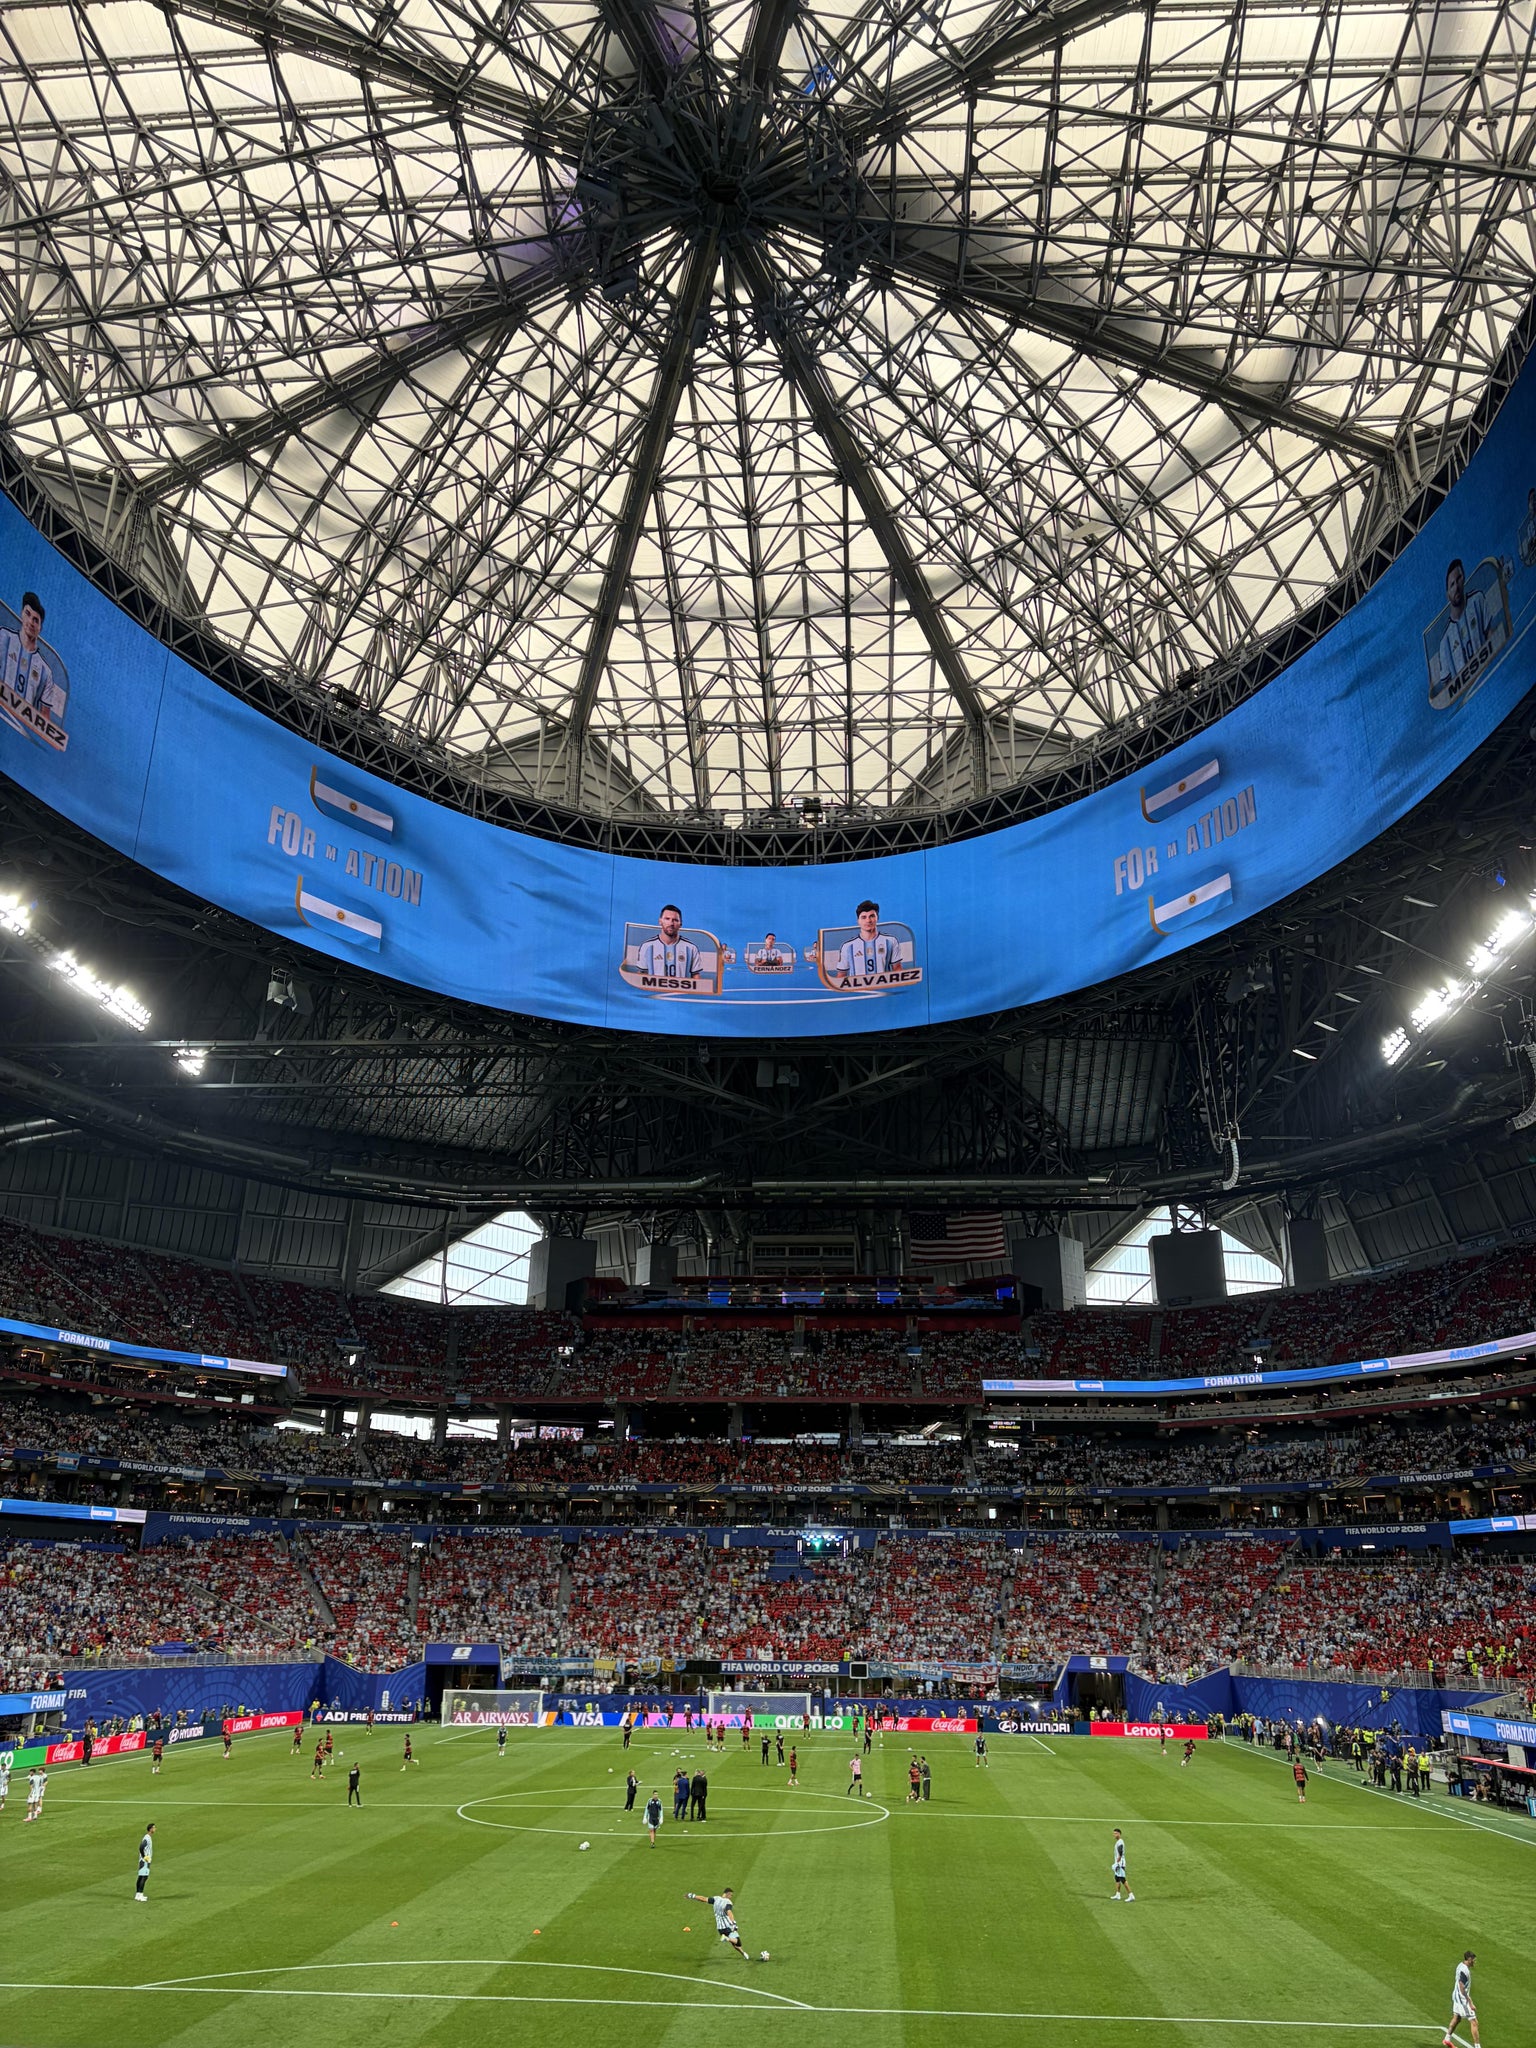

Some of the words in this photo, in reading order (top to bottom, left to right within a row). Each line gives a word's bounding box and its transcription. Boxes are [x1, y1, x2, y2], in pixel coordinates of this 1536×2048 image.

[1448, 641, 1494, 699] MESSI
[17, 674, 26, 693] 9
[867, 958, 874, 972] 9
[642, 977, 697, 990] MESSI
[840, 970, 921, 988] ÁLVAREZ
[58, 1331, 110, 1350] FORMATION
[1204, 1374, 1263, 1387] FORMATION
[119, 1461, 132, 1469] FIFA
[132, 1462, 153, 1472] WORLD
[154, 1465, 168, 1473] CUP
[1416, 1474, 1442, 1482] WORLD
[1442, 1472, 1453, 1480] CUP
[1454, 1470, 1474, 1478] 2026
[186, 1516, 211, 1524] WORLD
[1401, 1525, 1427, 1533] 2026
[721, 1663, 743, 1672] FIFA
[744, 1663, 781, 1672] WORLD
[782, 1663, 803, 1672] CUP
[803, 1664, 839, 1673] 2026
[68, 1689, 87, 1699] FIFA
[31, 1693, 66, 1709] FORMAT
[323, 1712, 348, 1721] ADI
[476, 1712, 529, 1723] AIRWAYS
[572, 1712, 604, 1725] VISA
[233, 1719, 253, 1732] Lenovo
[260, 1715, 287, 1727] Lenovo
[1020, 1721, 1070, 1733] HYUNDAI
[1124, 1723, 1174, 1737] Lenovo
[179, 1726, 204, 1739] HYUNDAI
